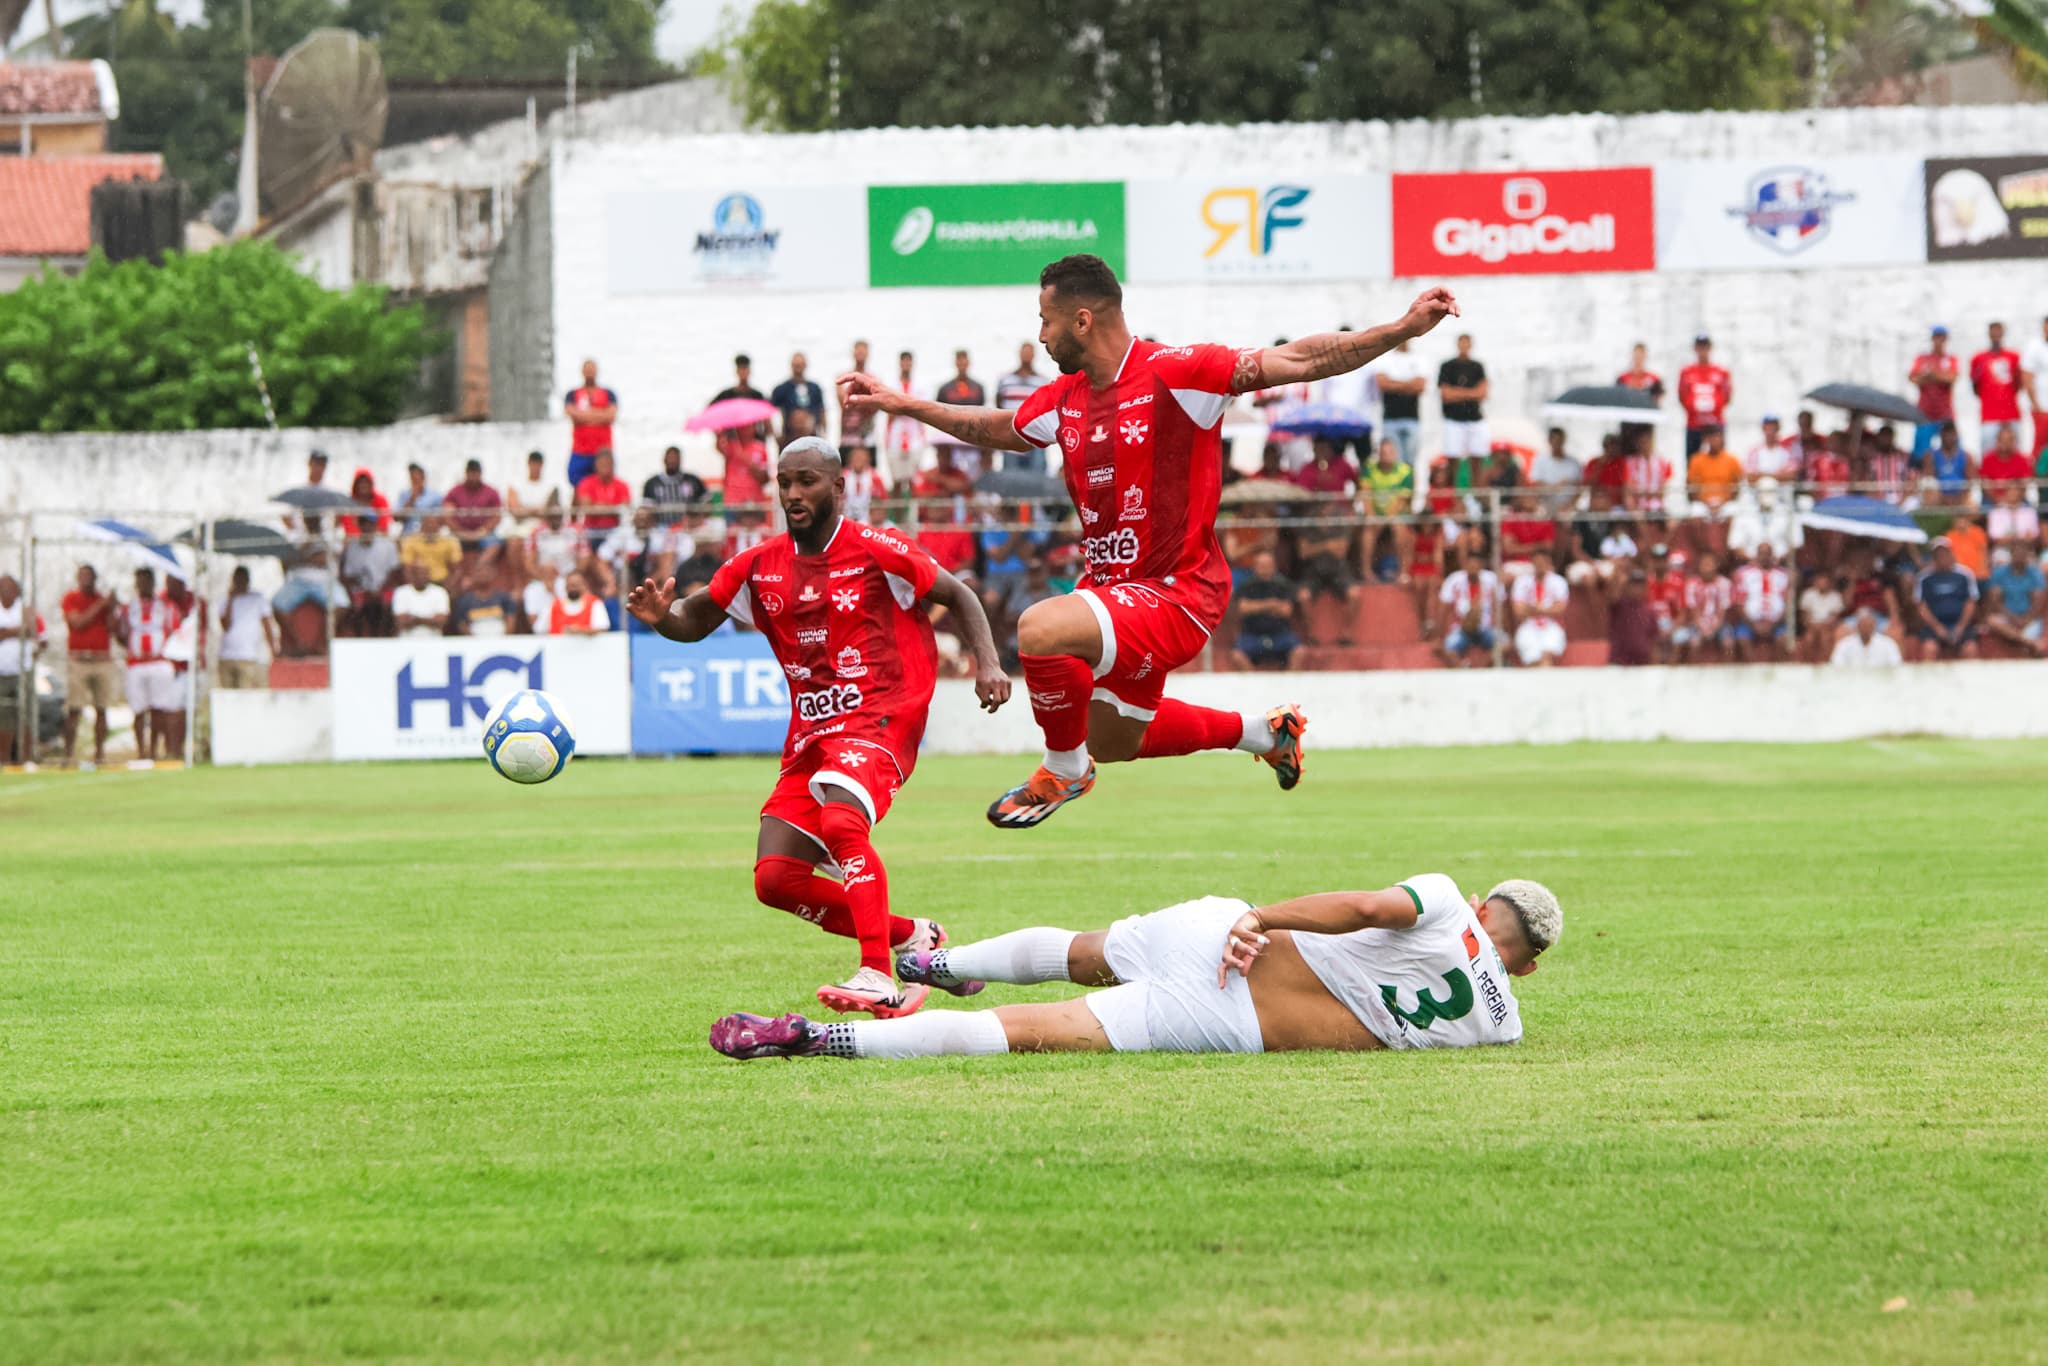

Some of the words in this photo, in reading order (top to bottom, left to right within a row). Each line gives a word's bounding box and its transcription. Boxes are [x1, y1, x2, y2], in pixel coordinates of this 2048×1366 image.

[1432, 214, 1616, 263] GigaCell
[1471, 957, 1481, 975] L.
[1377, 967, 1475, 1031] 3
[1477, 970, 1508, 1027] PEREIRA
